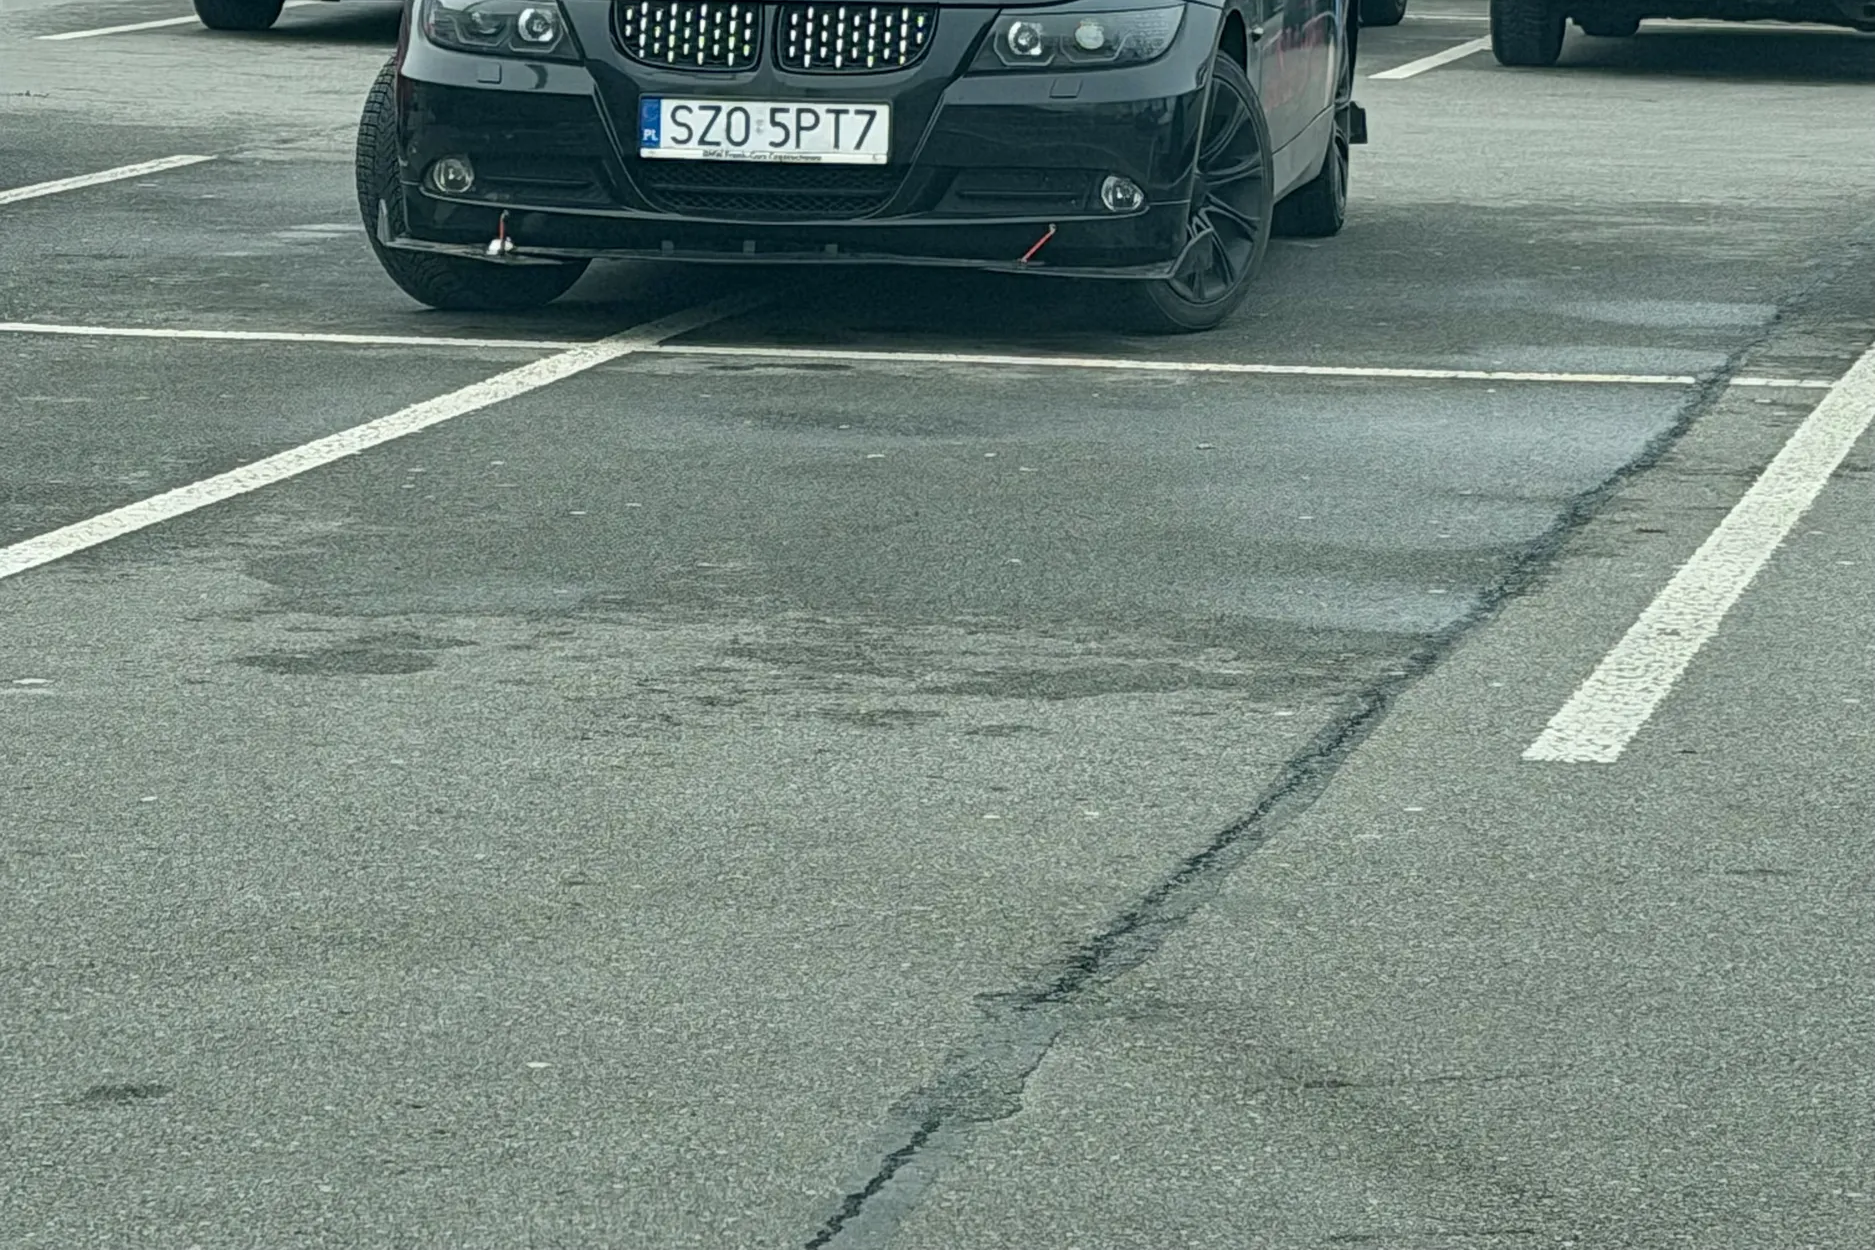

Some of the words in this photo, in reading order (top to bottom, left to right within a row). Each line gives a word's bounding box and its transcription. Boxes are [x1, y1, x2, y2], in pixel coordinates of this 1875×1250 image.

[642, 129, 659, 141] PL
[670, 104, 750, 148] SZO
[768, 107, 878, 151] 5PT7
